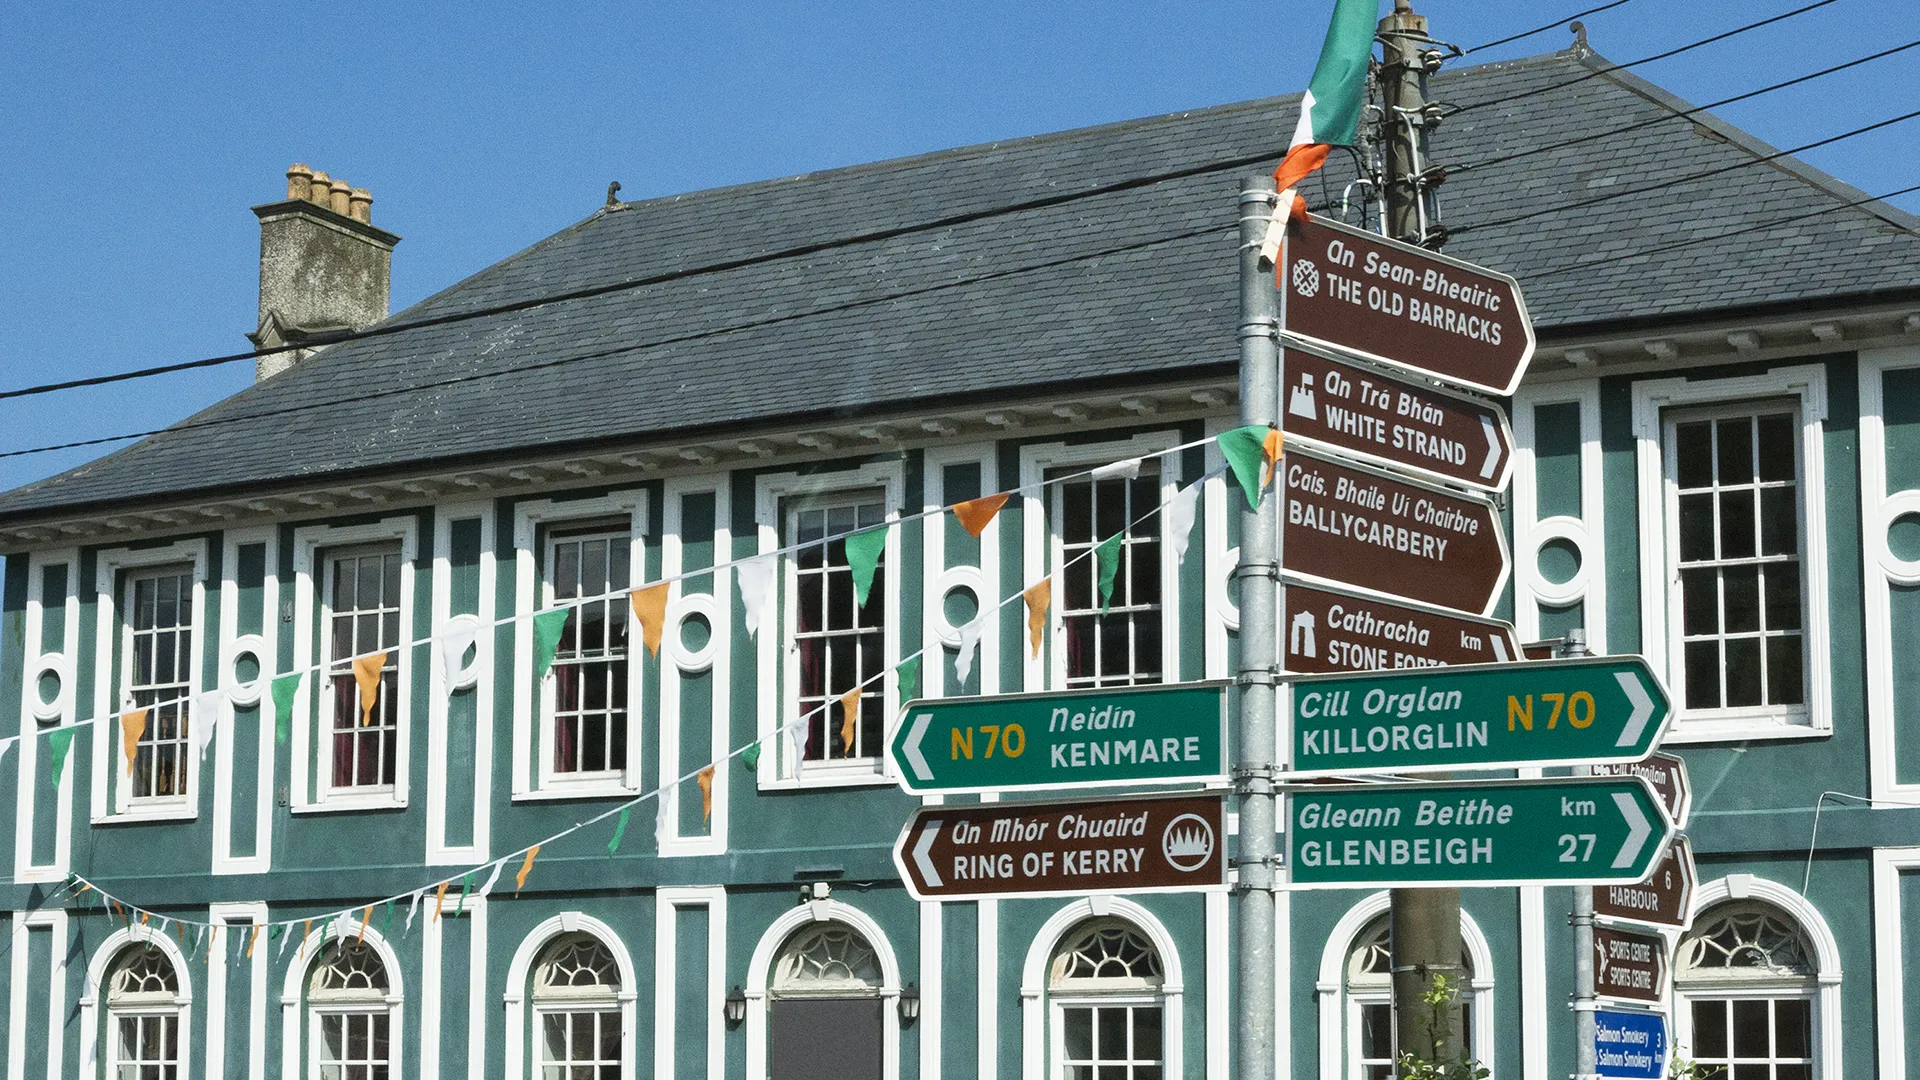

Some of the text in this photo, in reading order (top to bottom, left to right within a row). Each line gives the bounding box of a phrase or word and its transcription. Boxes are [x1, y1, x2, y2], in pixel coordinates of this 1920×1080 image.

[1363, 251, 1501, 312] Sean-Bheairic
[1327, 273, 1501, 345] THE OLD BARRACKS
[1361, 380, 1390, 410] Trá
[1397, 392, 1443, 426] Bhán
[1325, 404, 1466, 467] WHITE STRAND
[1335, 477, 1385, 511] Bhaile
[1392, 492, 1410, 517] Uí
[1414, 499, 1479, 536] Chairbre
[1289, 499, 1448, 561] BALLYCARBERY
[1328, 604, 1481, 651] Cathracha km
[1328, 640, 1388, 670] STONE
[1301, 687, 1461, 718] Cill Orglan
[1050, 706, 1134, 731] Neidín
[1052, 737, 1199, 767] KENMARE
[1304, 722, 1487, 754] KILLORGLIN
[990, 818, 1049, 842] Mhór
[1058, 811, 1148, 839] Chuaird
[1300, 797, 1595, 828] Gleann Beithe km
[955, 848, 1144, 879] RING OF KERRY
[1301, 835, 1596, 866] GLENBEIGH 27
[1665, 870, 1672, 890] 6
[1609, 885, 1659, 912] HARBOUR
[1610, 940, 1650, 963] SPORTS CENTRE
[1610, 966, 1651, 990] SPORTS CENTRE
[1597, 1025, 1661, 1048] Salmon Smokery 3
[1599, 1049, 1623, 1066] Salmon
[1624, 1051, 1652, 1072] Smokery
